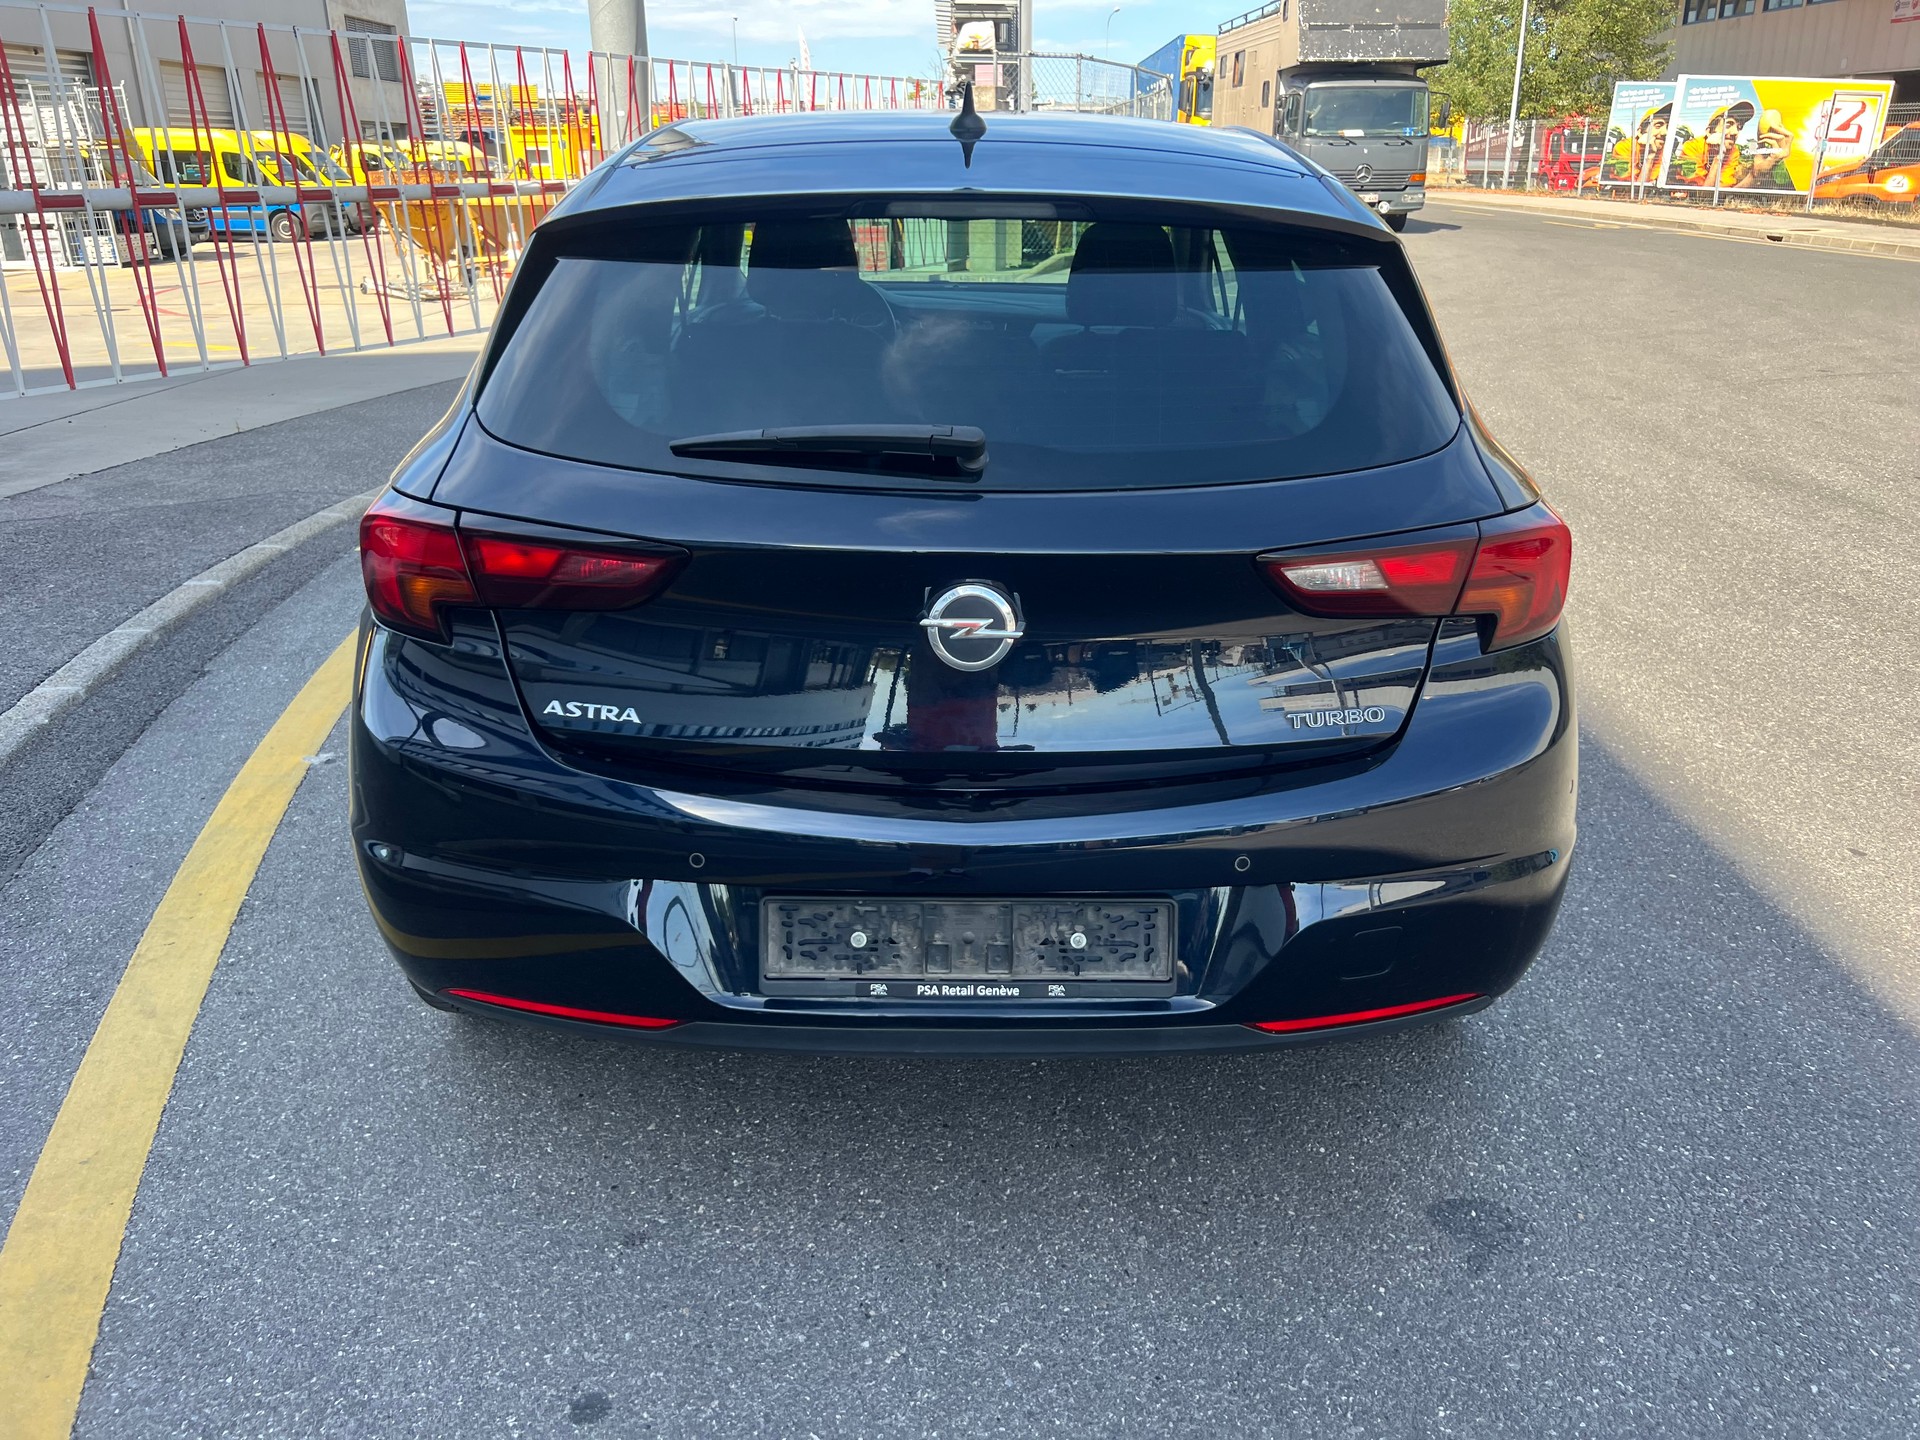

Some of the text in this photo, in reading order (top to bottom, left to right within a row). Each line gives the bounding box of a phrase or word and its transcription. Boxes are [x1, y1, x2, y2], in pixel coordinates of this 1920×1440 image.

[543, 700, 642, 724] ASTRA
[1286, 707, 1385, 729] TURBO
[917, 984, 1020, 996] PSA Retail Genève
[1048, 984, 1066, 992] PSA
